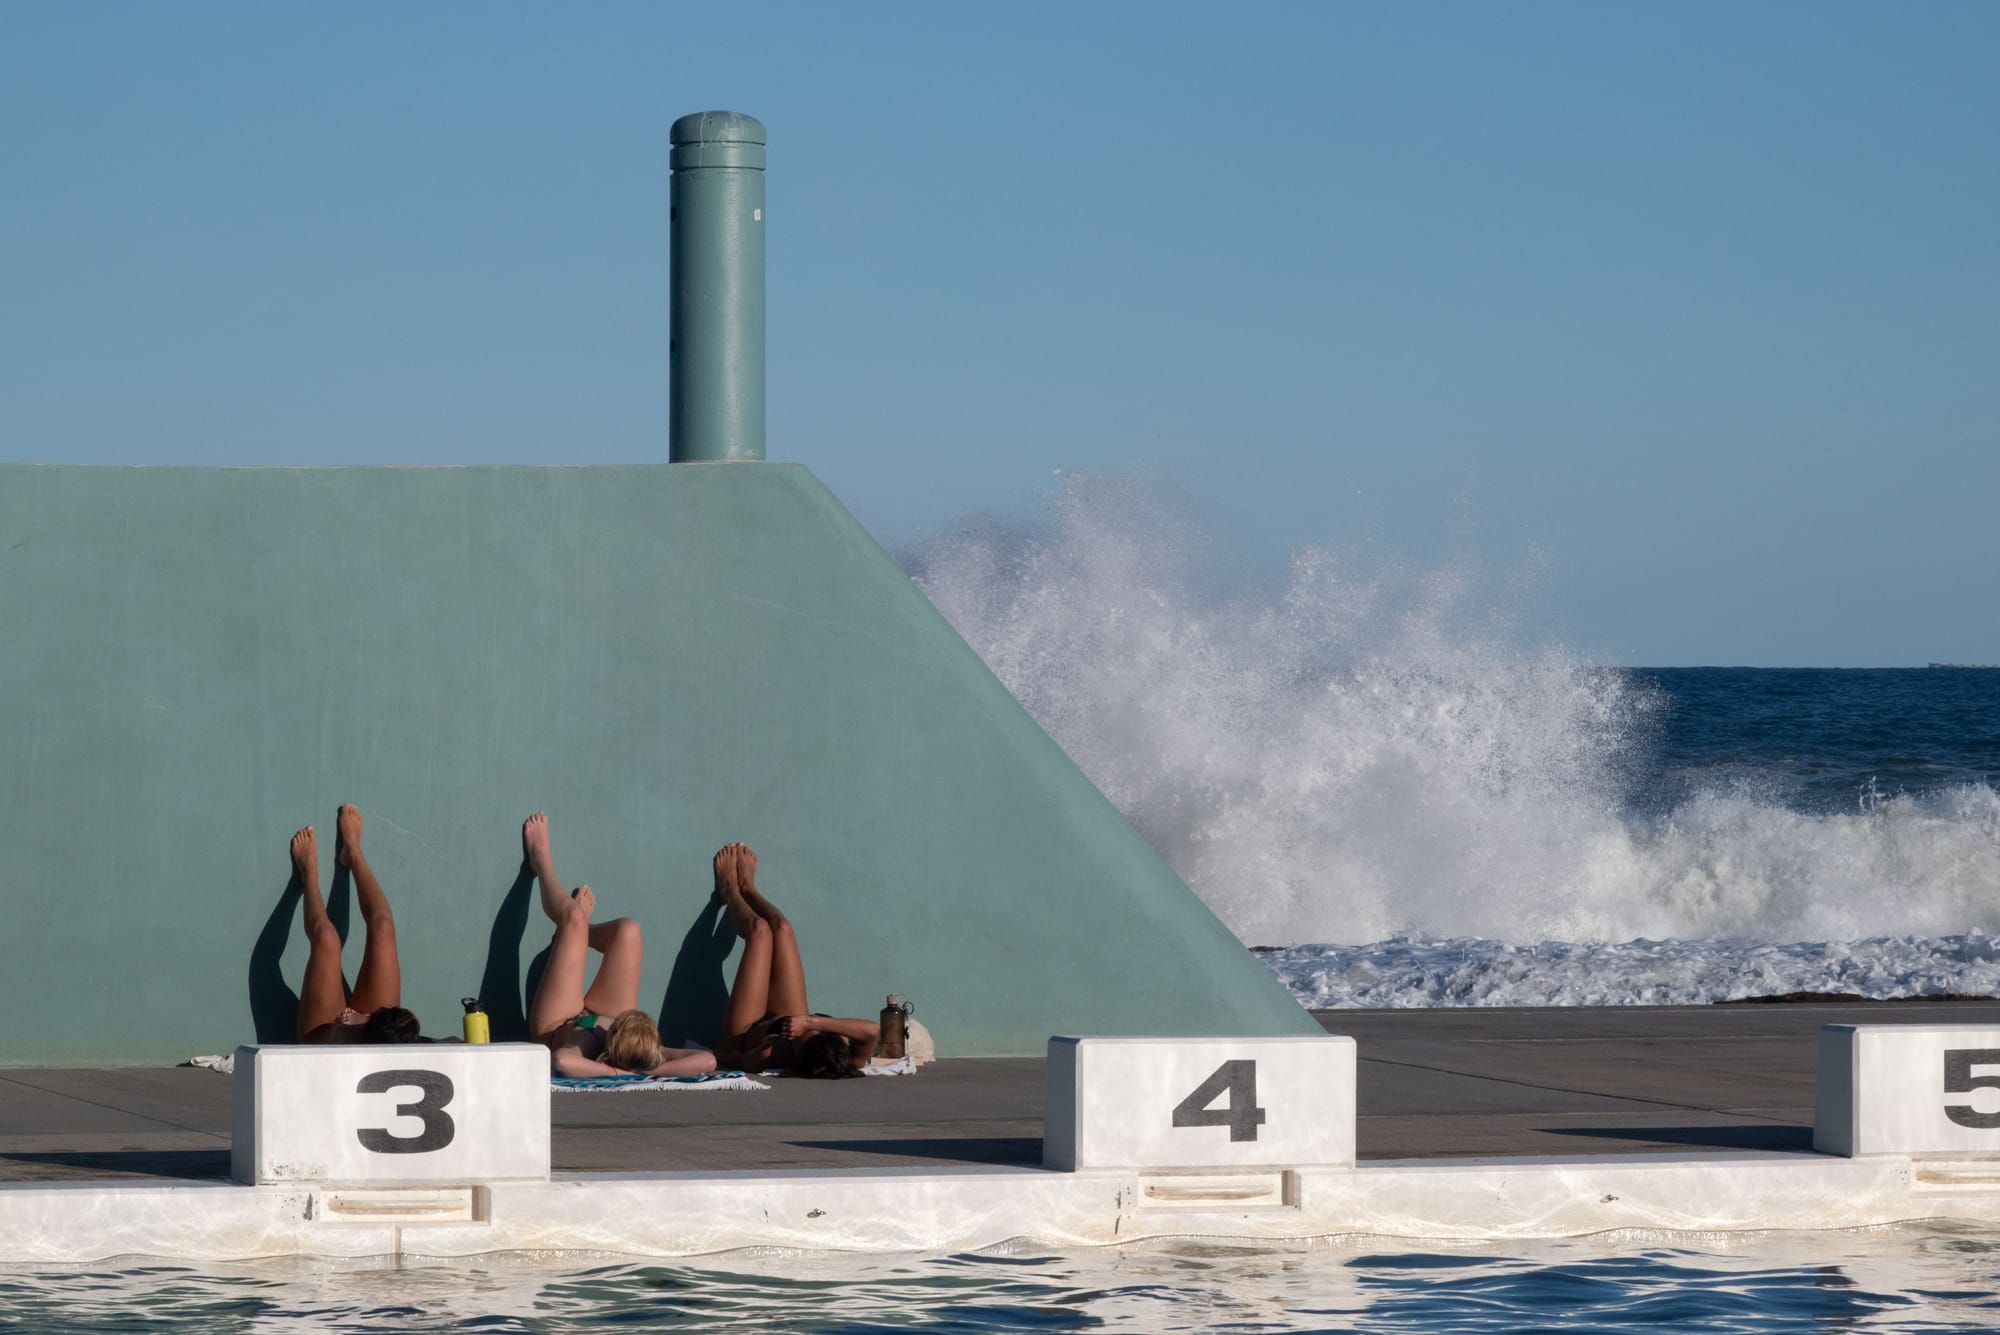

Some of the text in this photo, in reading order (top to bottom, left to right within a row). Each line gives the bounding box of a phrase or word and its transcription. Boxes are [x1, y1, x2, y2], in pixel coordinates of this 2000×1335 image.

[356, 1069, 455, 1154] 3
[1172, 1059, 1266, 1142] 4
[1943, 1048, 2000, 1129] 5
